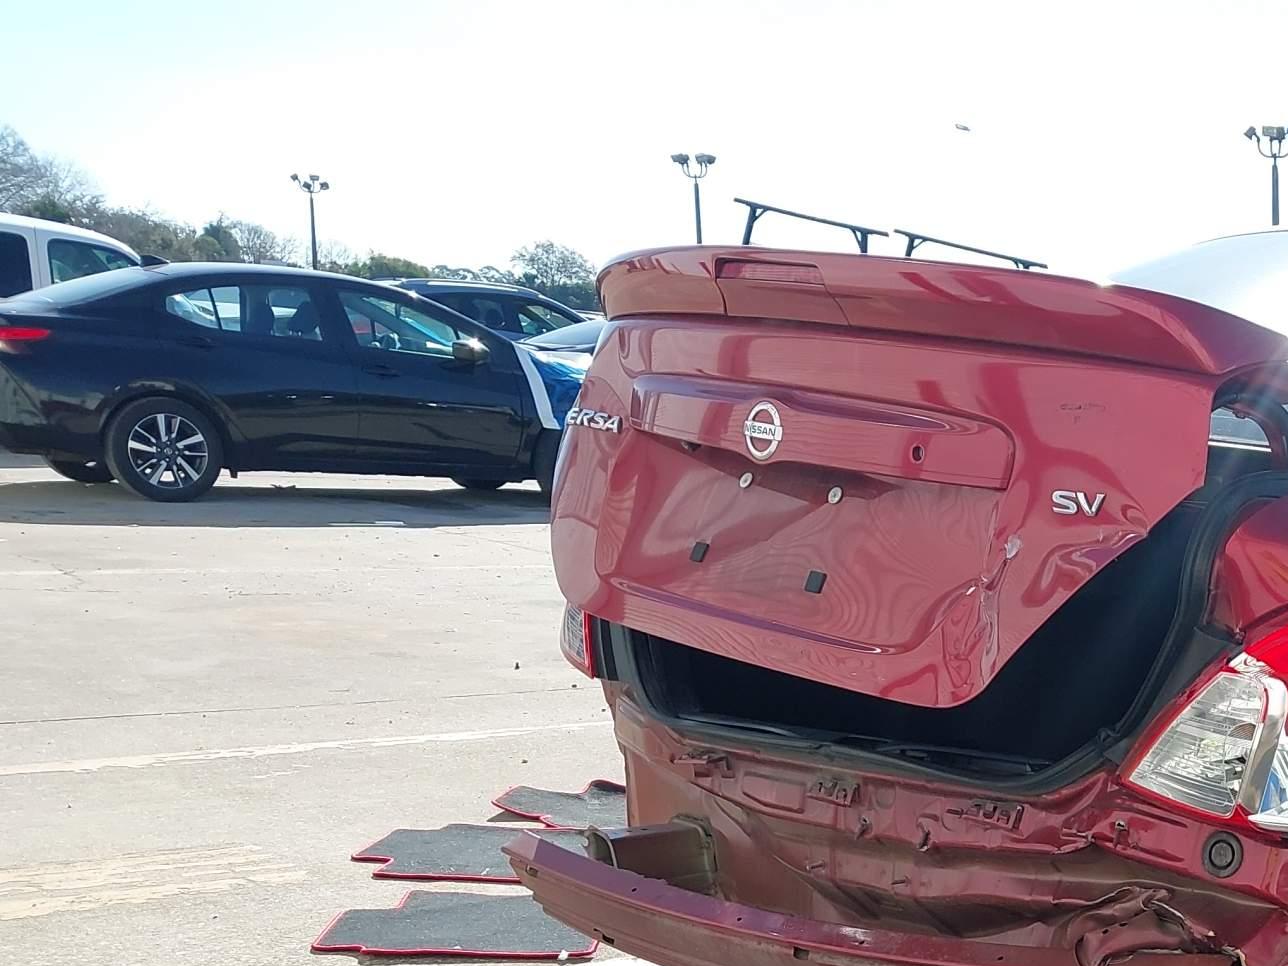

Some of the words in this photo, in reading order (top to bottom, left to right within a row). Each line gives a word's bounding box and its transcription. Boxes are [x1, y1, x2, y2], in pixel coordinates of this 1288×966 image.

[565, 407, 621, 433] ERSA
[744, 422, 777, 437] NISSAN
[1051, 490, 1106, 517] SV
